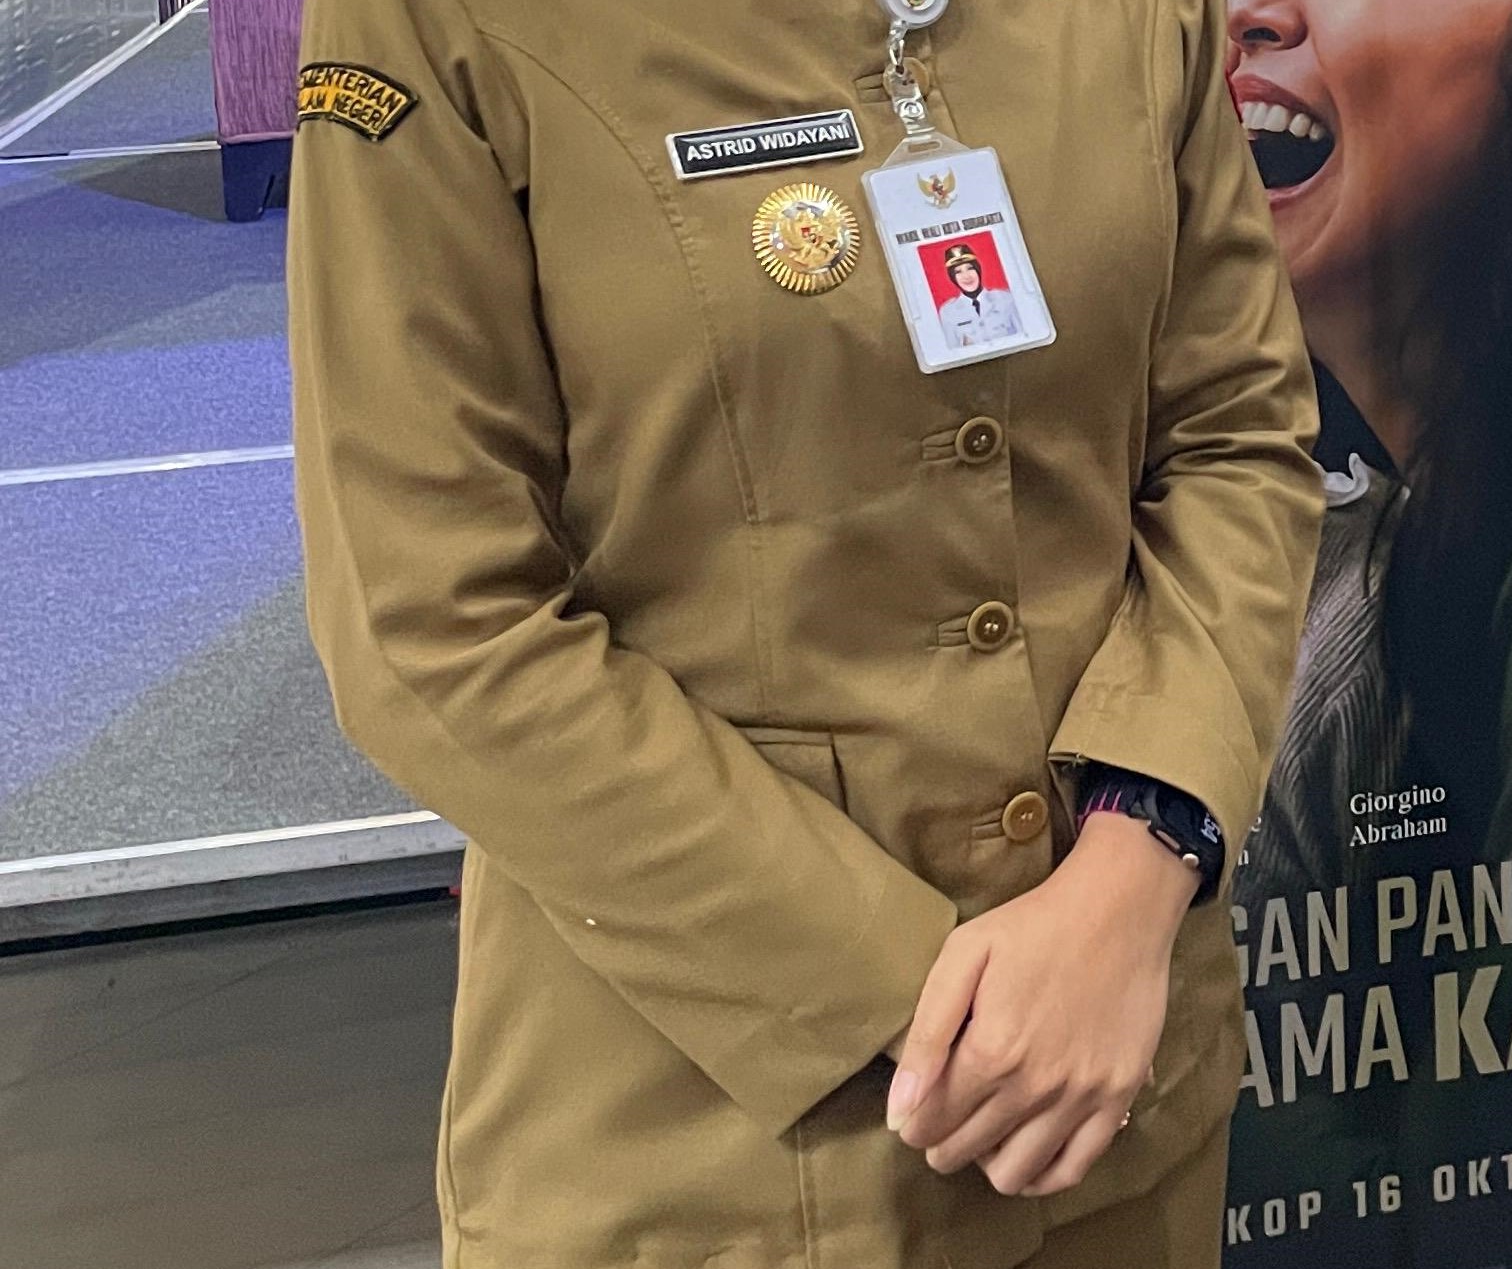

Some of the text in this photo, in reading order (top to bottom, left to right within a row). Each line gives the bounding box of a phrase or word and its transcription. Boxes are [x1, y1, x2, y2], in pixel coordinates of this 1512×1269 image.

[686, 124, 850, 162] ASTRID WIDAYANI
[1349, 785, 1446, 817] Giorgino
[1349, 816, 1447, 848] Abraham
[1352, 1175, 1401, 1219] 16
